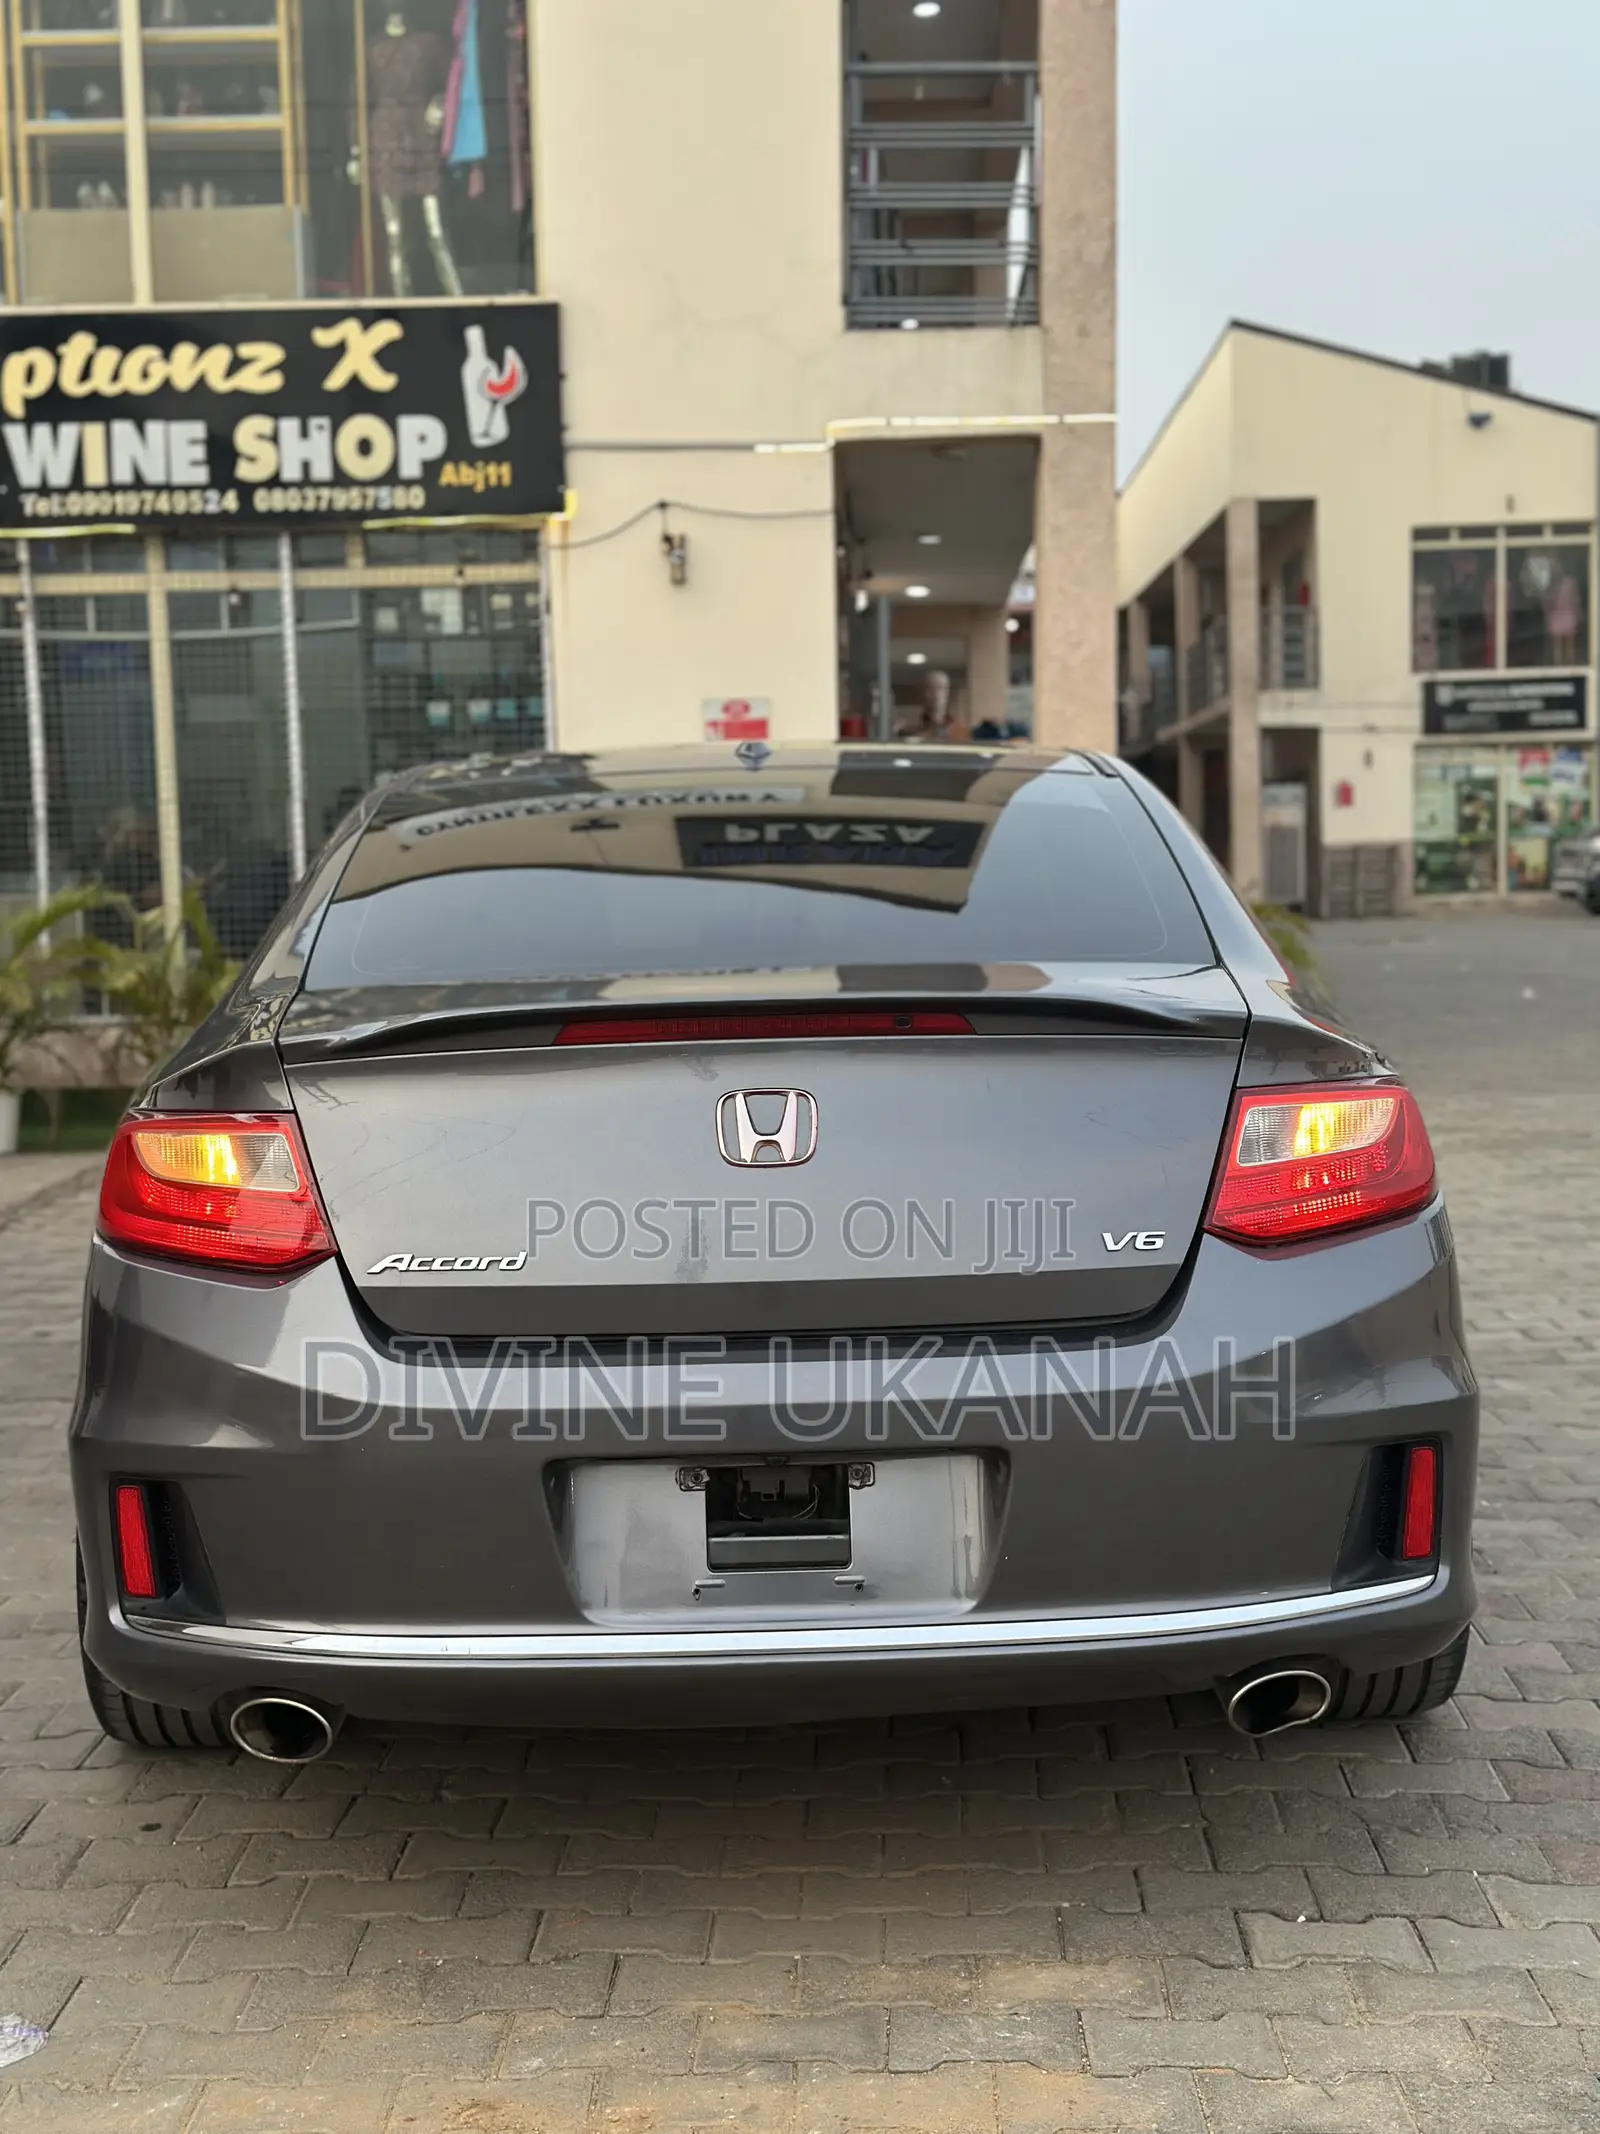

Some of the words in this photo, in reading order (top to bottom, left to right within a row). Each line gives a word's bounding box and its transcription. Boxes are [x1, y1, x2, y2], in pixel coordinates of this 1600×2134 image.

[2, 420, 210, 488] WINE
[233, 413, 448, 483] SHOP
[1101, 1231, 1167, 1252] V6
[366, 1250, 528, 1275] Accord
